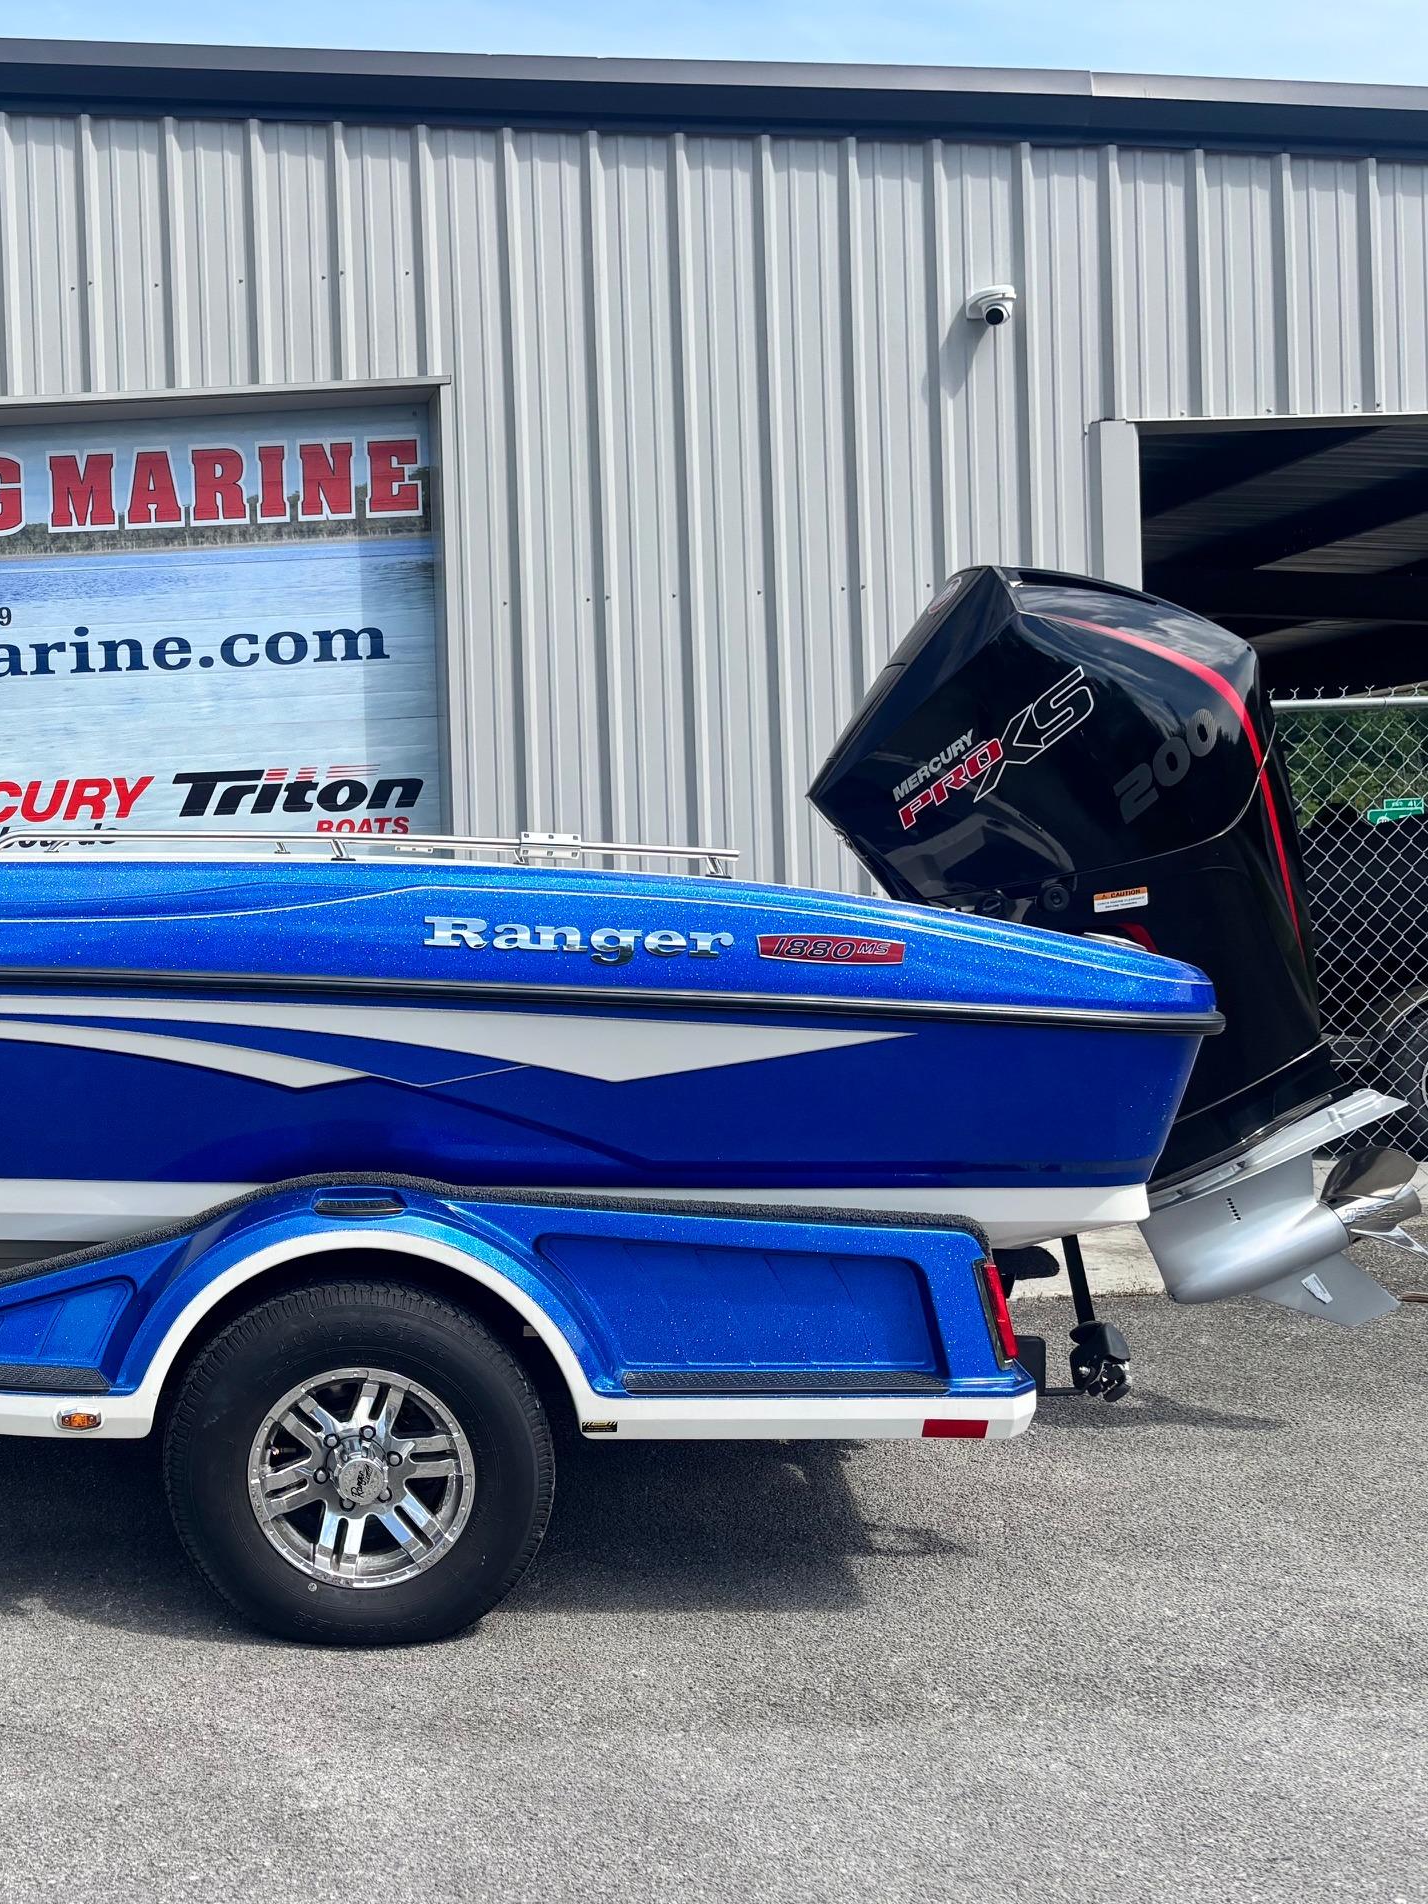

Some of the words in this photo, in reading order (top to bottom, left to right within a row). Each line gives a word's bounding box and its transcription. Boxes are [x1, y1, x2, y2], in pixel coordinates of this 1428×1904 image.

[46, 434, 422, 533] MARINE
[172, 768, 424, 817] Triton
[892, 728, 974, 801] MERCURY
[898, 737, 1003, 830] PRO
[1113, 708, 1218, 825] 200
[1110, 889, 1141, 898] CAUTION
[424, 915, 735, 966] Ranger
